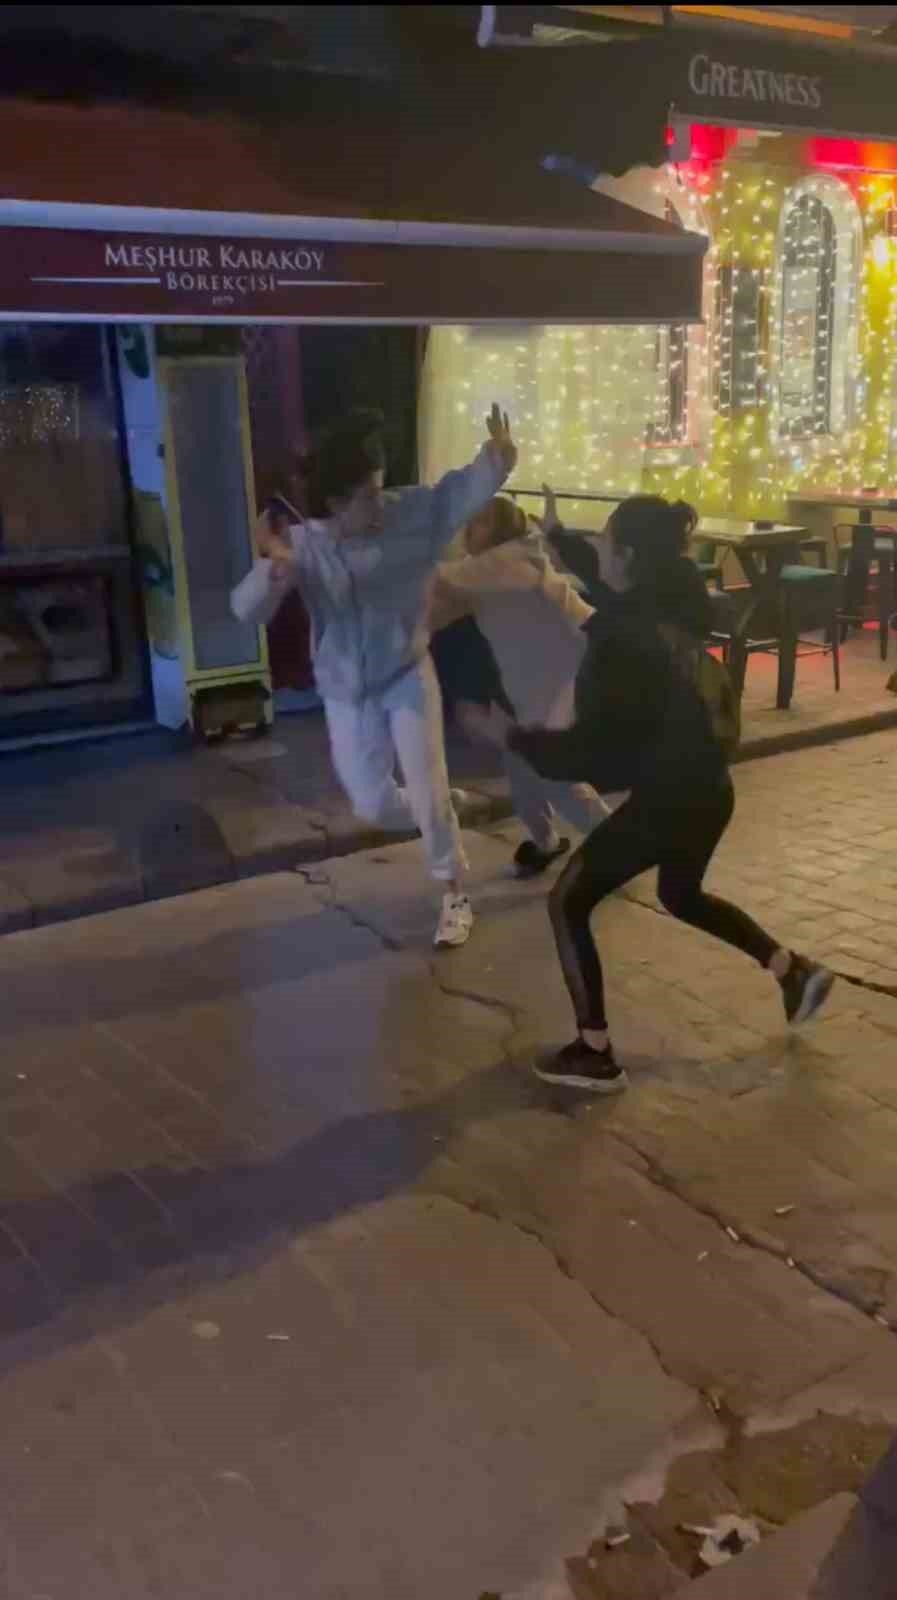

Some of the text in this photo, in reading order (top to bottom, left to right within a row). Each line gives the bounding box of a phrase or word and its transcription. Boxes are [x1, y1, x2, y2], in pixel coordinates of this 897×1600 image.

[688, 54, 822, 109] GREATNESS
[104, 243, 325, 272] MEŞHUR KARAKÖY
